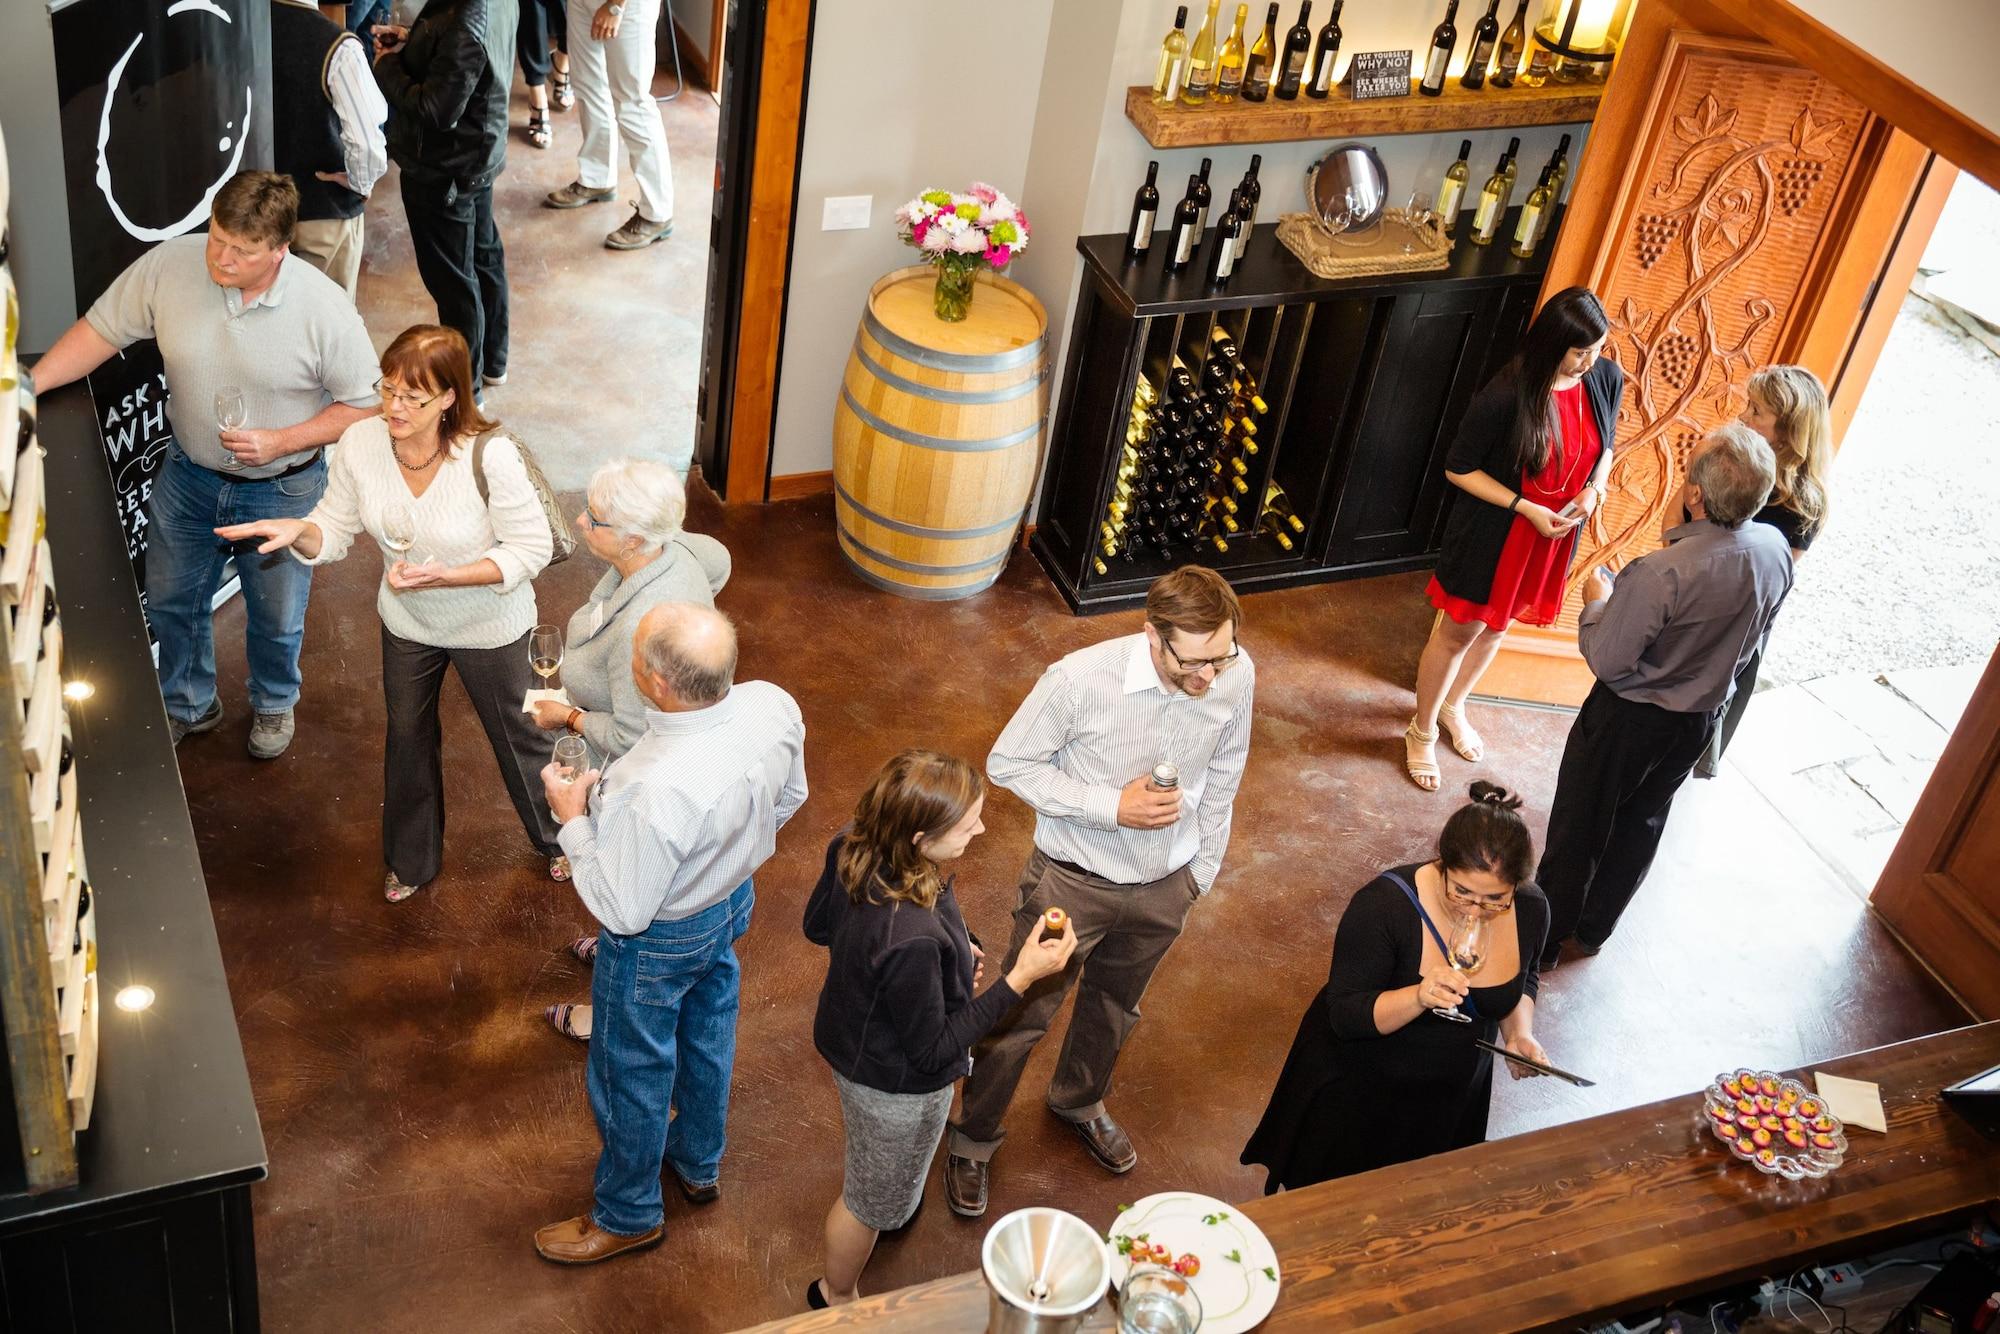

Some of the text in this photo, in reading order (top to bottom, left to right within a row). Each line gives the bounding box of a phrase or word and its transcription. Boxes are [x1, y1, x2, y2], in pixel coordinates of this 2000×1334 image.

[1374, 50, 1409, 59] YOURSELF
[1358, 57, 1409, 70] WHY NOT
[1372, 76, 1398, 84] WHERE
[1356, 84, 1385, 92] TAKES
[1389, 82, 1408, 90] YOU
[106, 383, 149, 428] ASK
[106, 393, 171, 462] WH
